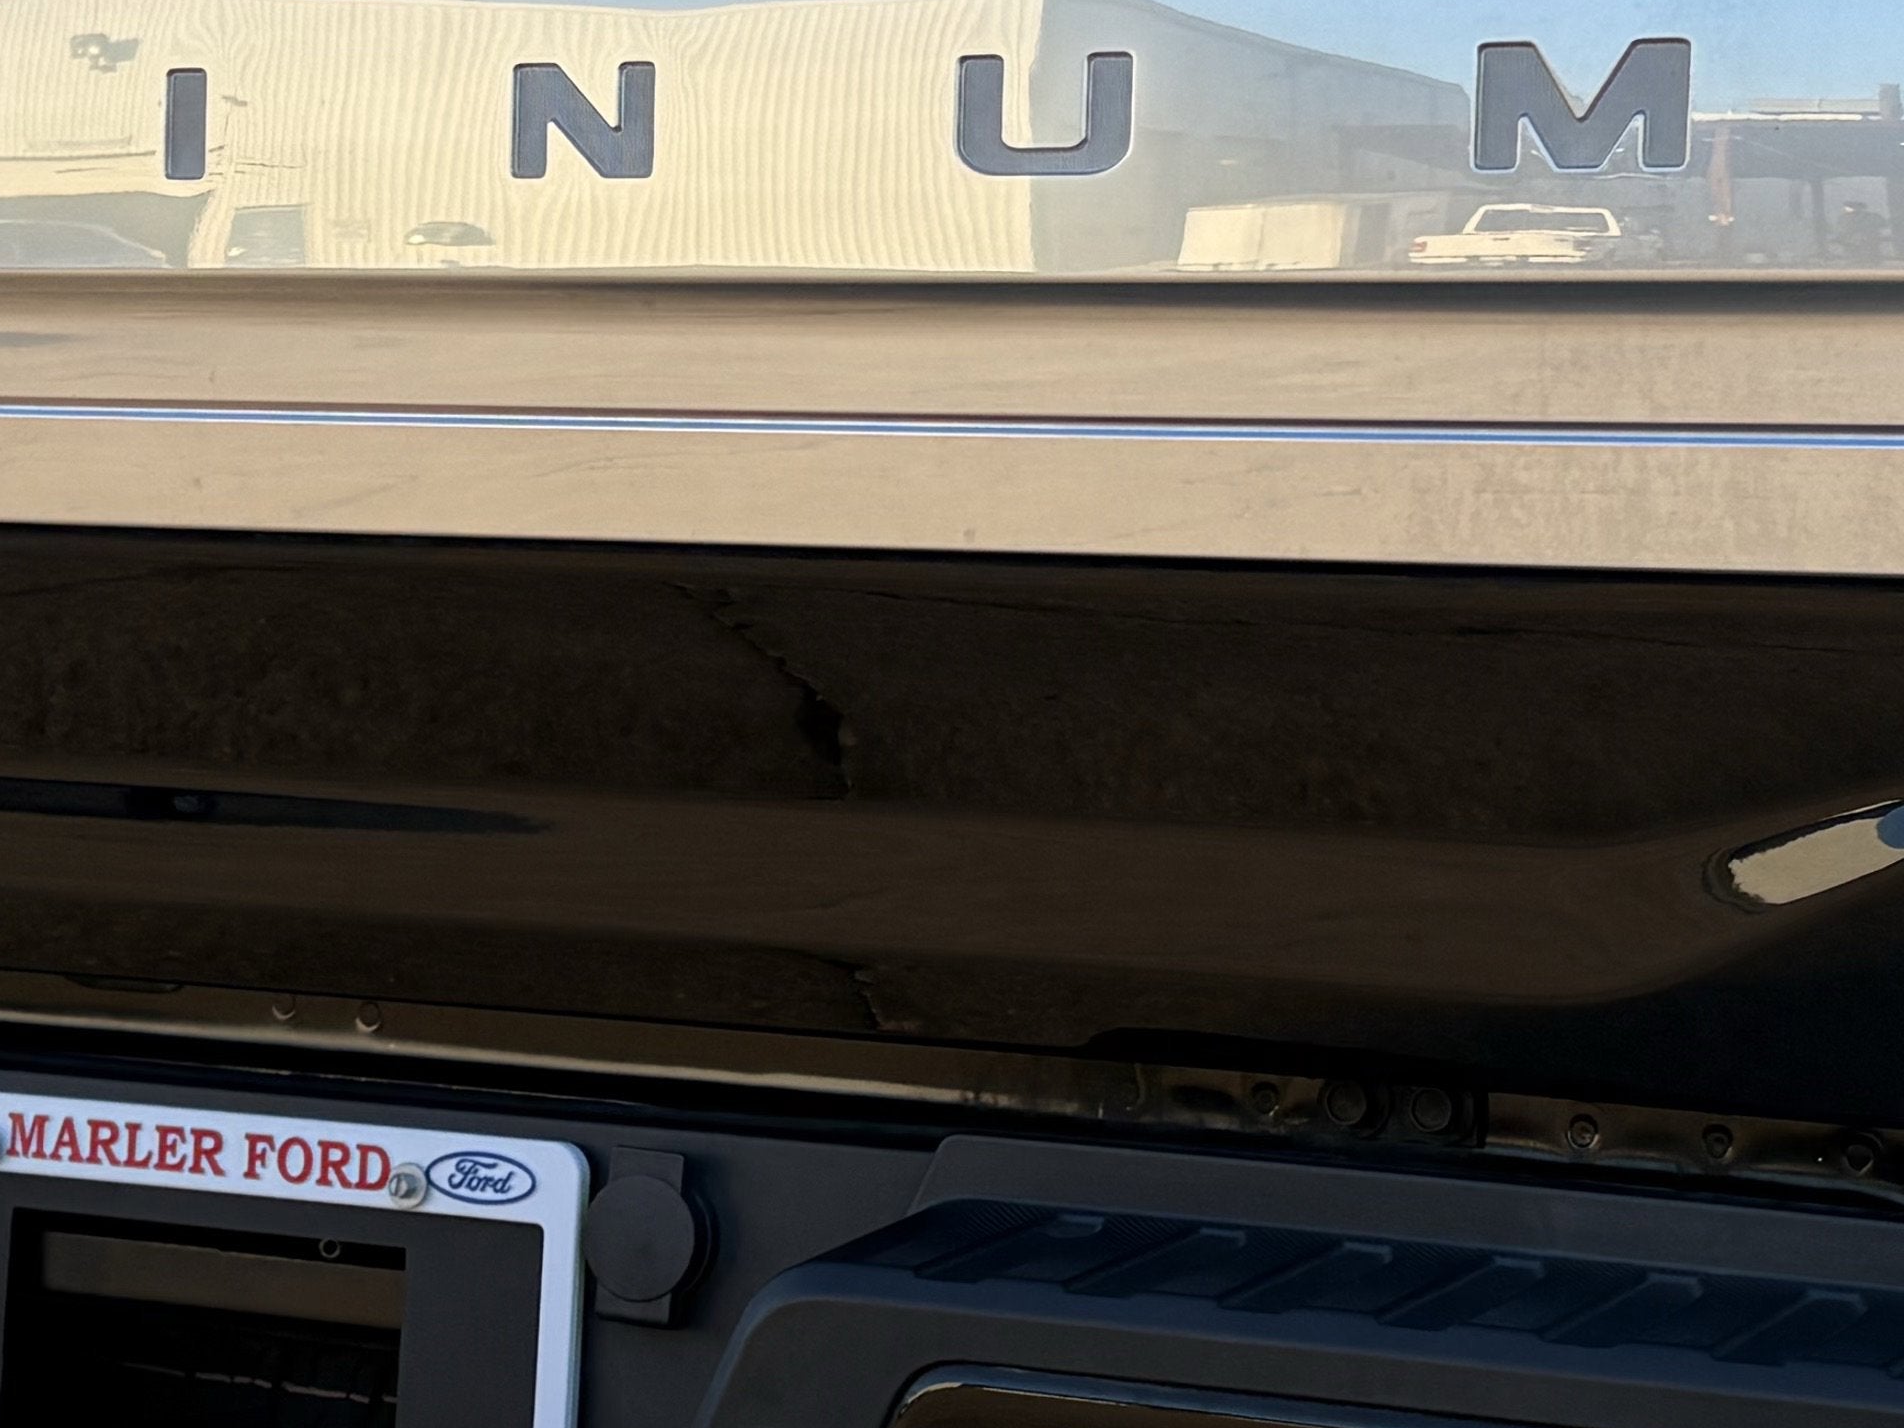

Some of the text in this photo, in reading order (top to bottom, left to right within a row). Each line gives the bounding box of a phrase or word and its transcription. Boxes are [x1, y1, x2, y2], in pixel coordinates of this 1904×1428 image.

[6, 1111, 393, 1193] MARLER FORD
[447, 1155, 514, 1196] Ford
